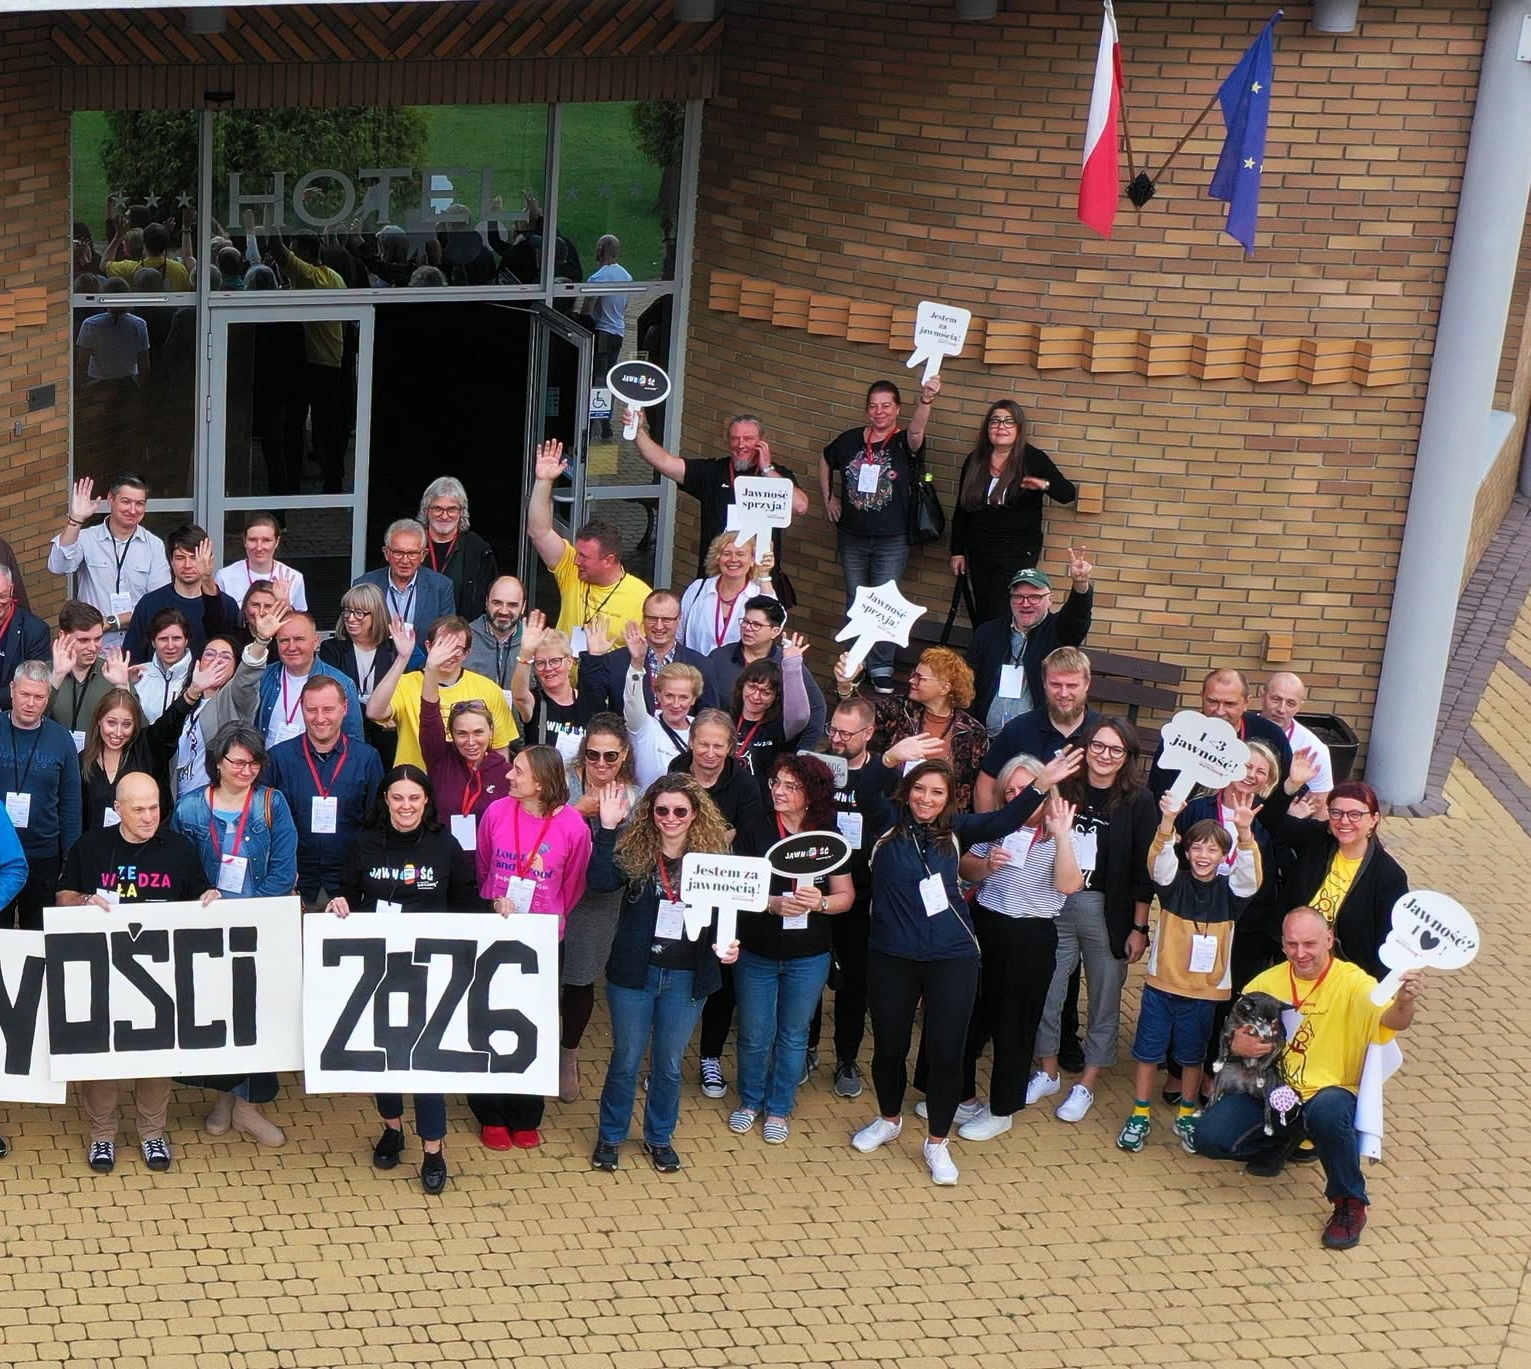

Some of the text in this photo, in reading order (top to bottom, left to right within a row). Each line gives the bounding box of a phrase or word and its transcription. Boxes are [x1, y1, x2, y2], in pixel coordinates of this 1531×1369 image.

[227, 167, 531, 228] HOTEL
[930, 312, 957, 324] Jestem
[742, 488, 789, 500] Jawność
[742, 500, 787, 512] sprzyja!
[866, 591, 908, 619] Jawność
[861, 603, 900, 629] sprzyja!
[1199, 732, 1227, 752] I <3
[1168, 734, 1239, 774] jawność!
[495, 860, 517, 872] and
[693, 863, 759, 880] Jestem za
[685, 878, 761, 898] jawnością!
[1402, 897, 1476, 953] Jawność?
[1411, 924, 1421, 936] I
[321, 938, 539, 1074] 2026
